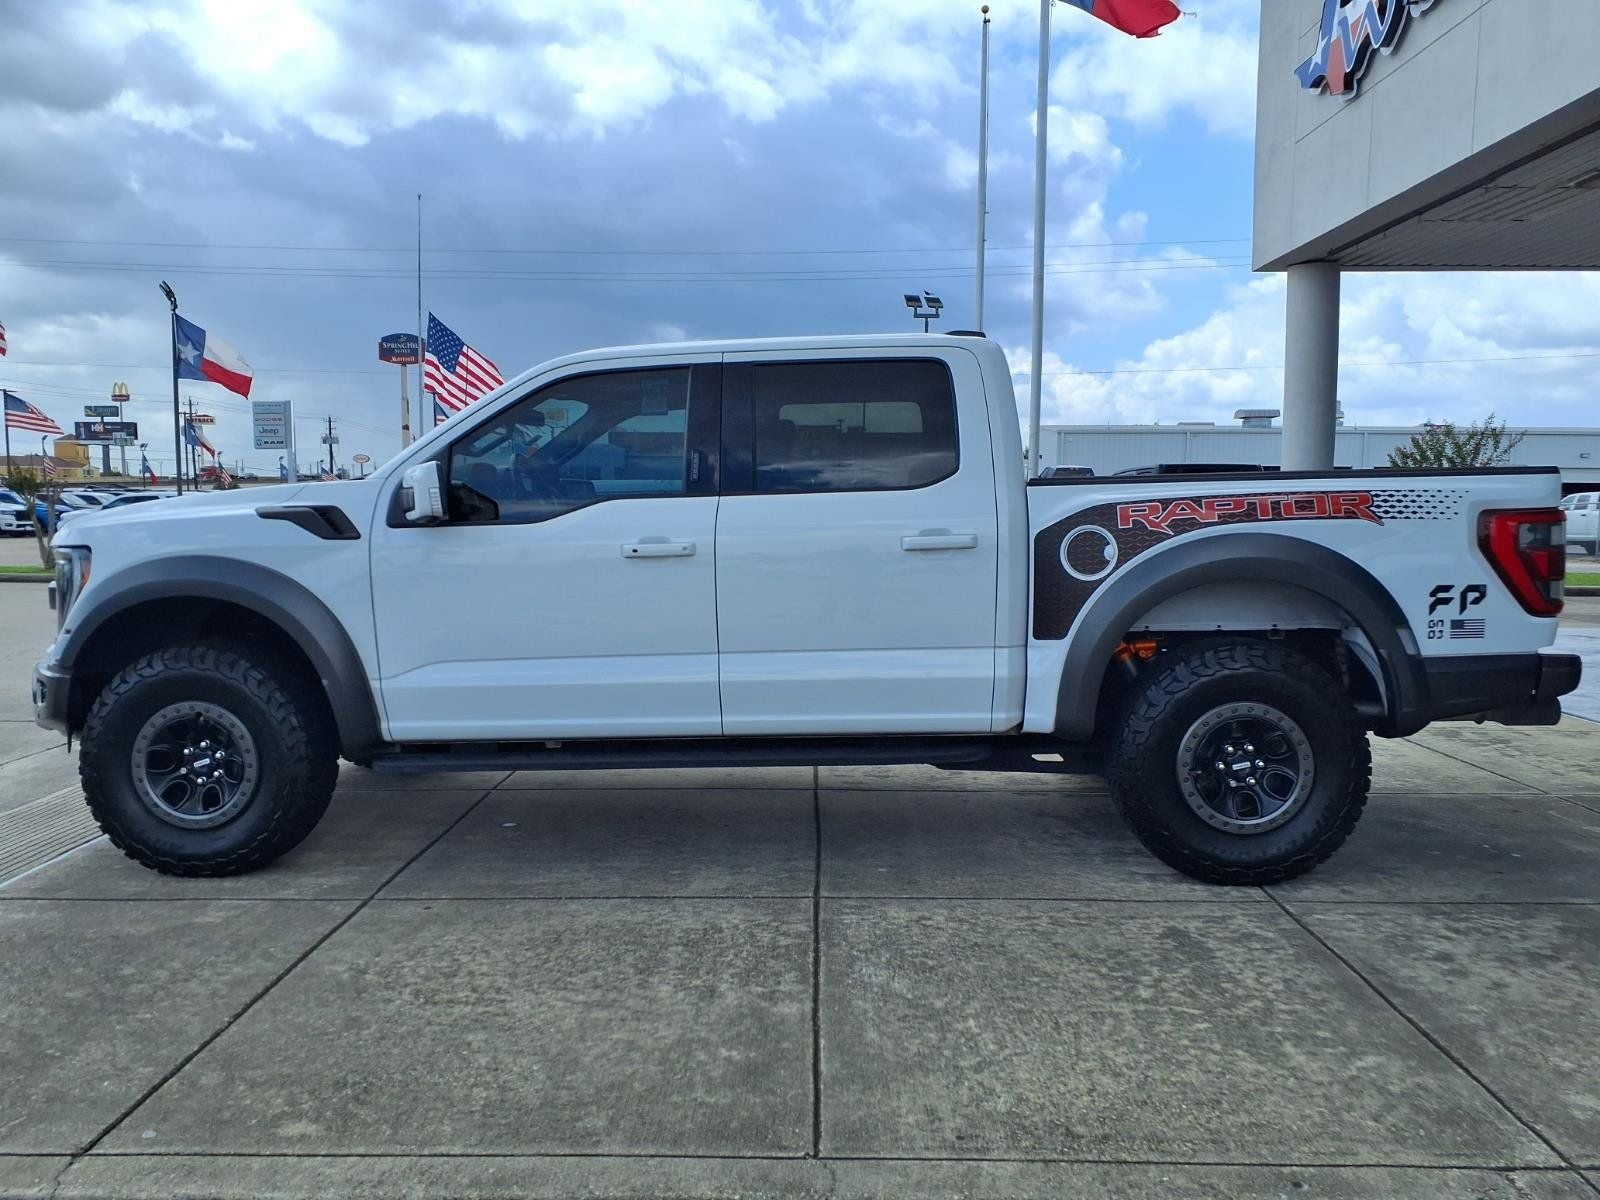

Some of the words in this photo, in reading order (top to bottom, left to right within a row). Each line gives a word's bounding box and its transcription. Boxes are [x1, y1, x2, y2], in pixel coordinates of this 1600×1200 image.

[258, 427, 279, 435] Jeep
[1116, 491, 1382, 535] RAPTOR
[1428, 584, 1487, 616] FP
